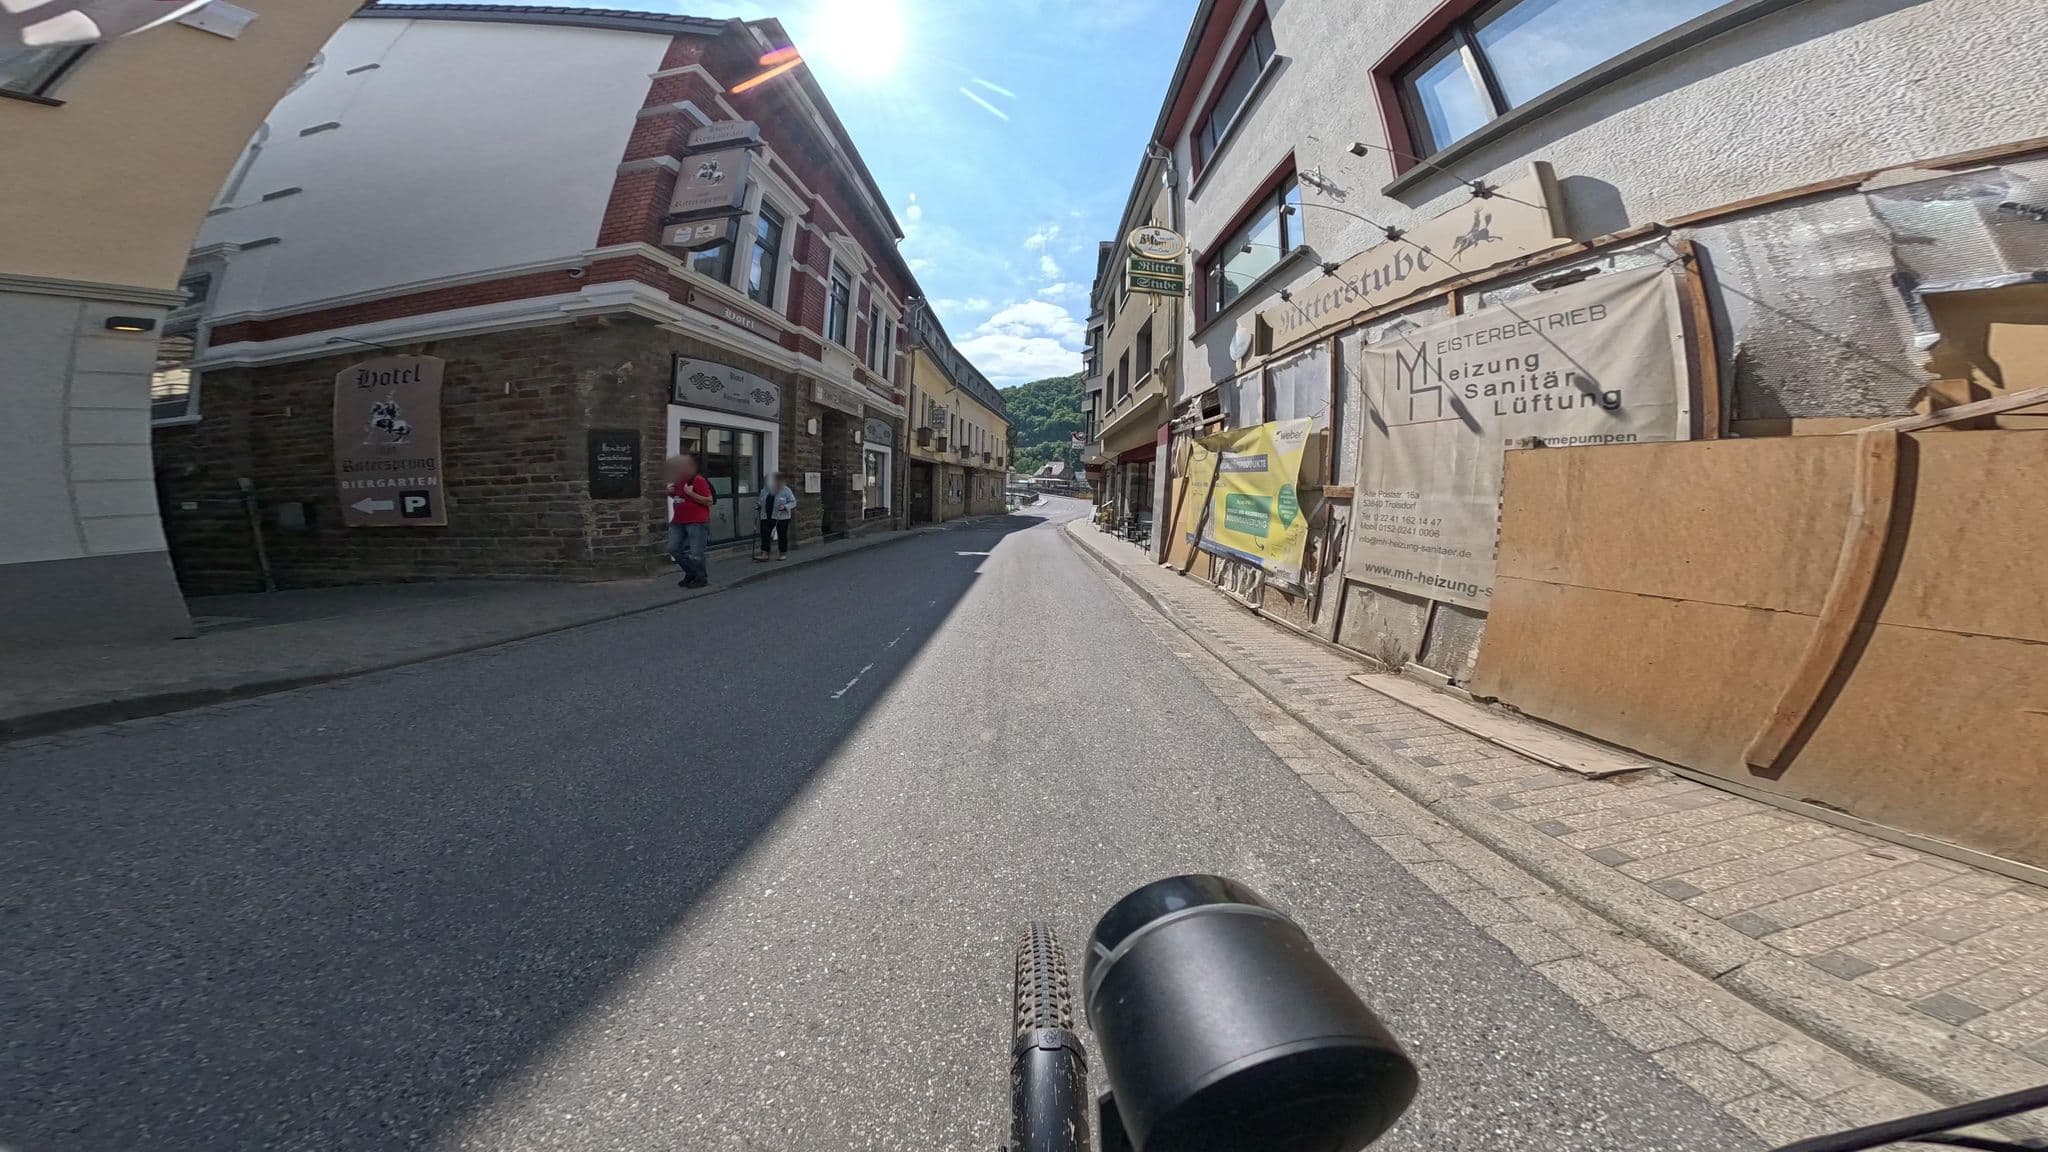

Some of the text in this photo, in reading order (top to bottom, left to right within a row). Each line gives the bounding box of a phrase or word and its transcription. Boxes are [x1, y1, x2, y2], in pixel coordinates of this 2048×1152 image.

[1138, 261, 1177, 273] Ritter
[1137, 278, 1177, 290] Stube
[1279, 244, 1433, 336] Ritterstube
[724, 308, 755, 329] Hotel
[356, 363, 422, 390] Hotel
[1464, 370, 1576, 399] Sanitär
[1494, 388, 1623, 417] Lüftung
[1280, 429, 1304, 441] weber
[342, 477, 438, 489] BIERGARTEN
[404, 495, 426, 513] P
[1385, 500, 1416, 510] Troisdorf
[1402, 515, 1416, 525] 162
[1419, 517, 1429, 526] 14
[1430, 518, 1442, 527] 47
